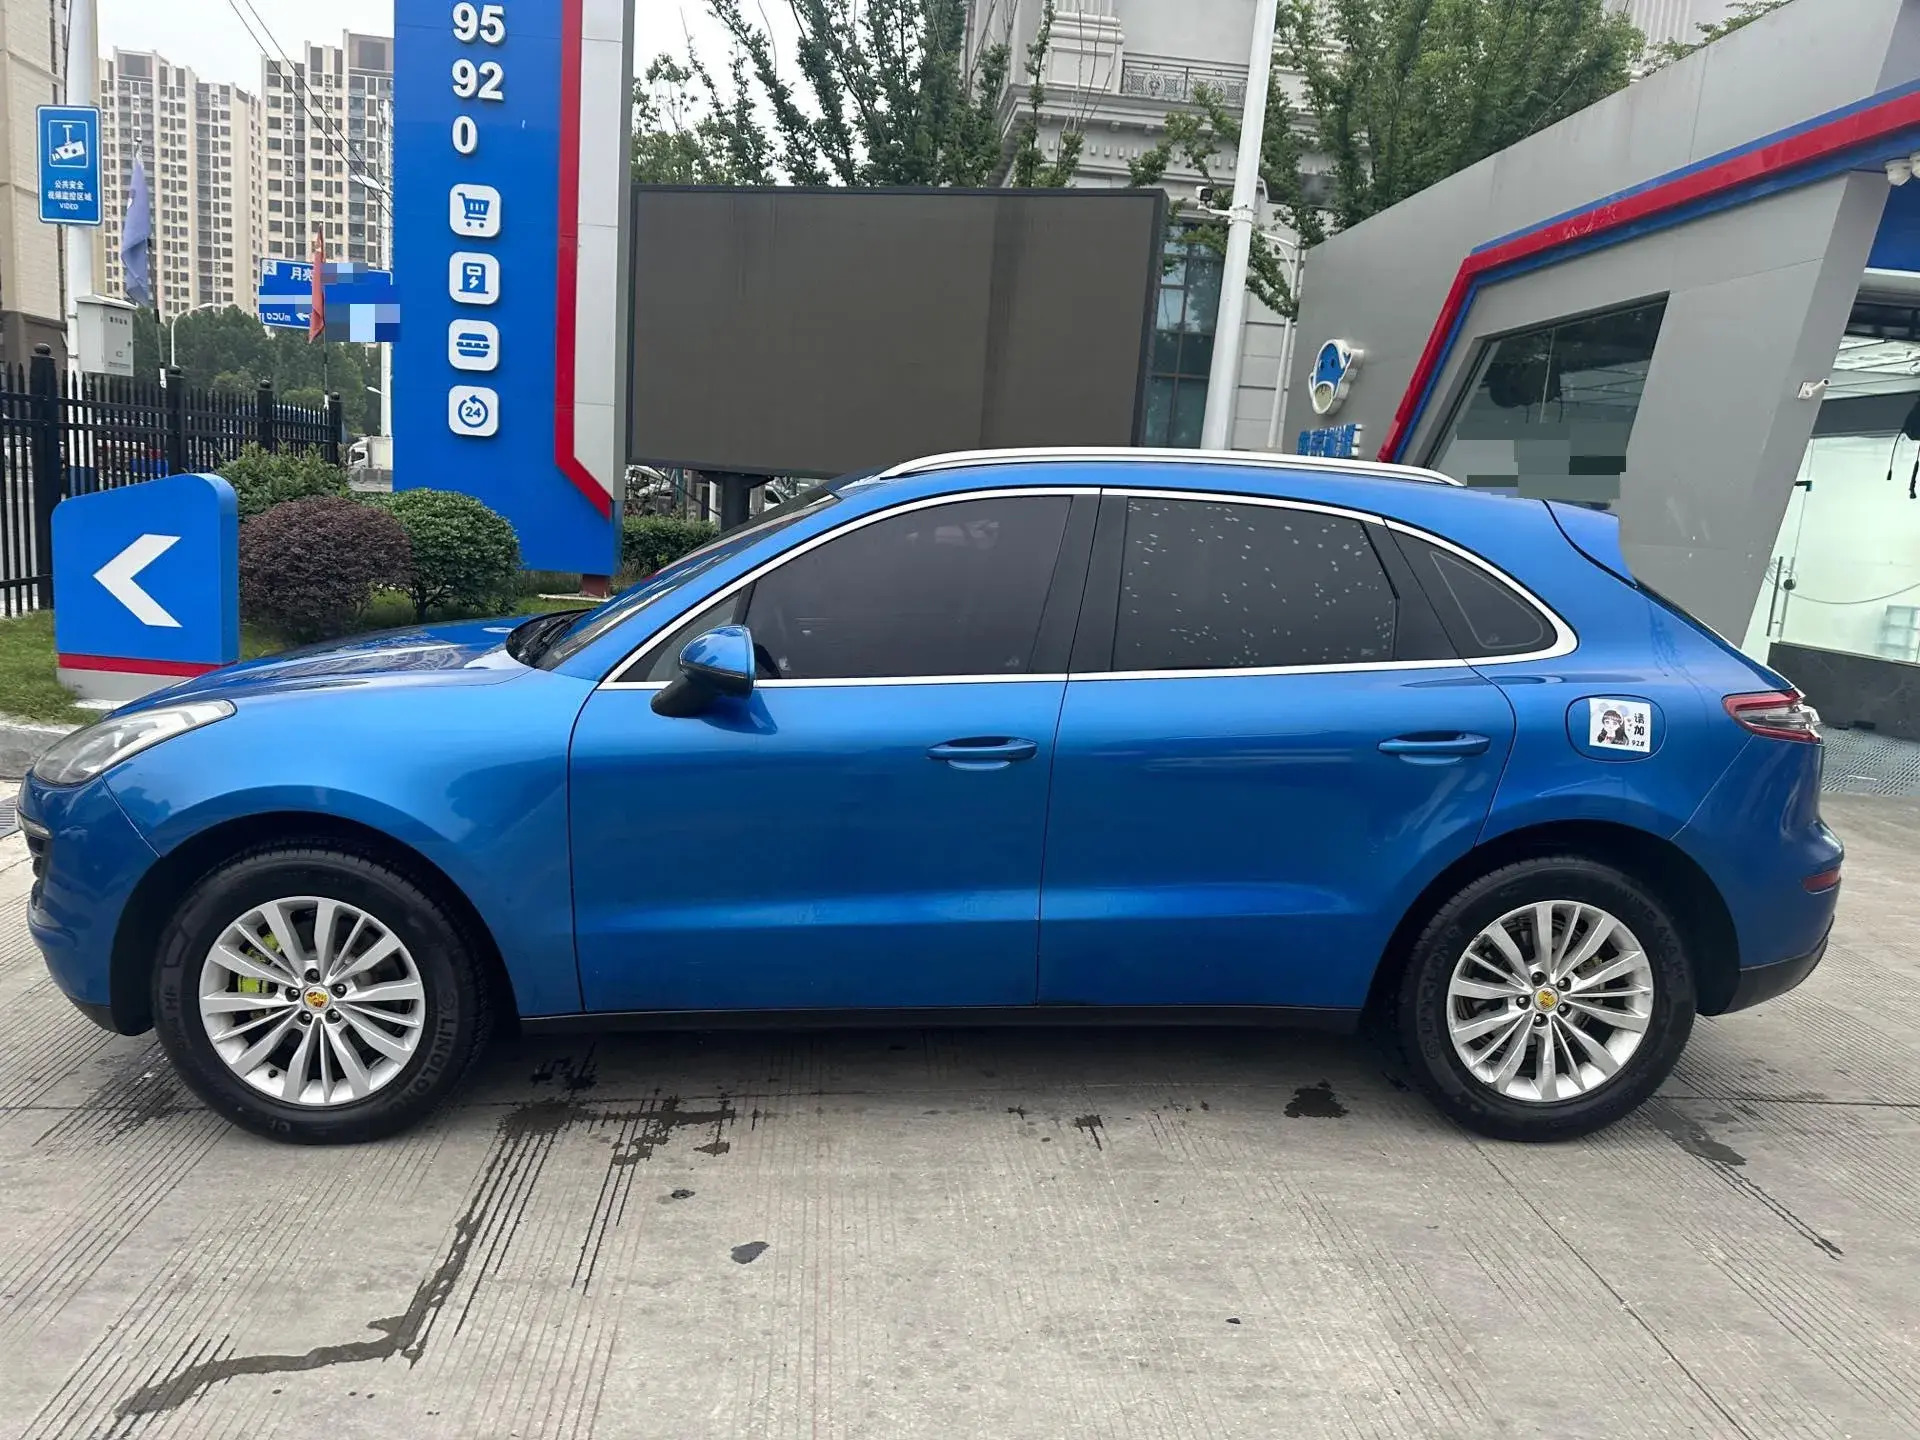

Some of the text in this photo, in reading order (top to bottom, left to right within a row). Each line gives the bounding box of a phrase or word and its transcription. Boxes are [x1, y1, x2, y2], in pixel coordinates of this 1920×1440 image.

[452, 2, 506, 44] 95
[452, 58, 504, 101] 92
[452, 115, 478, 154] 0
[54, 180, 84, 190] 公共安全
[59, 202, 79, 210] VIDEO
[465, 406, 482, 418] 24
